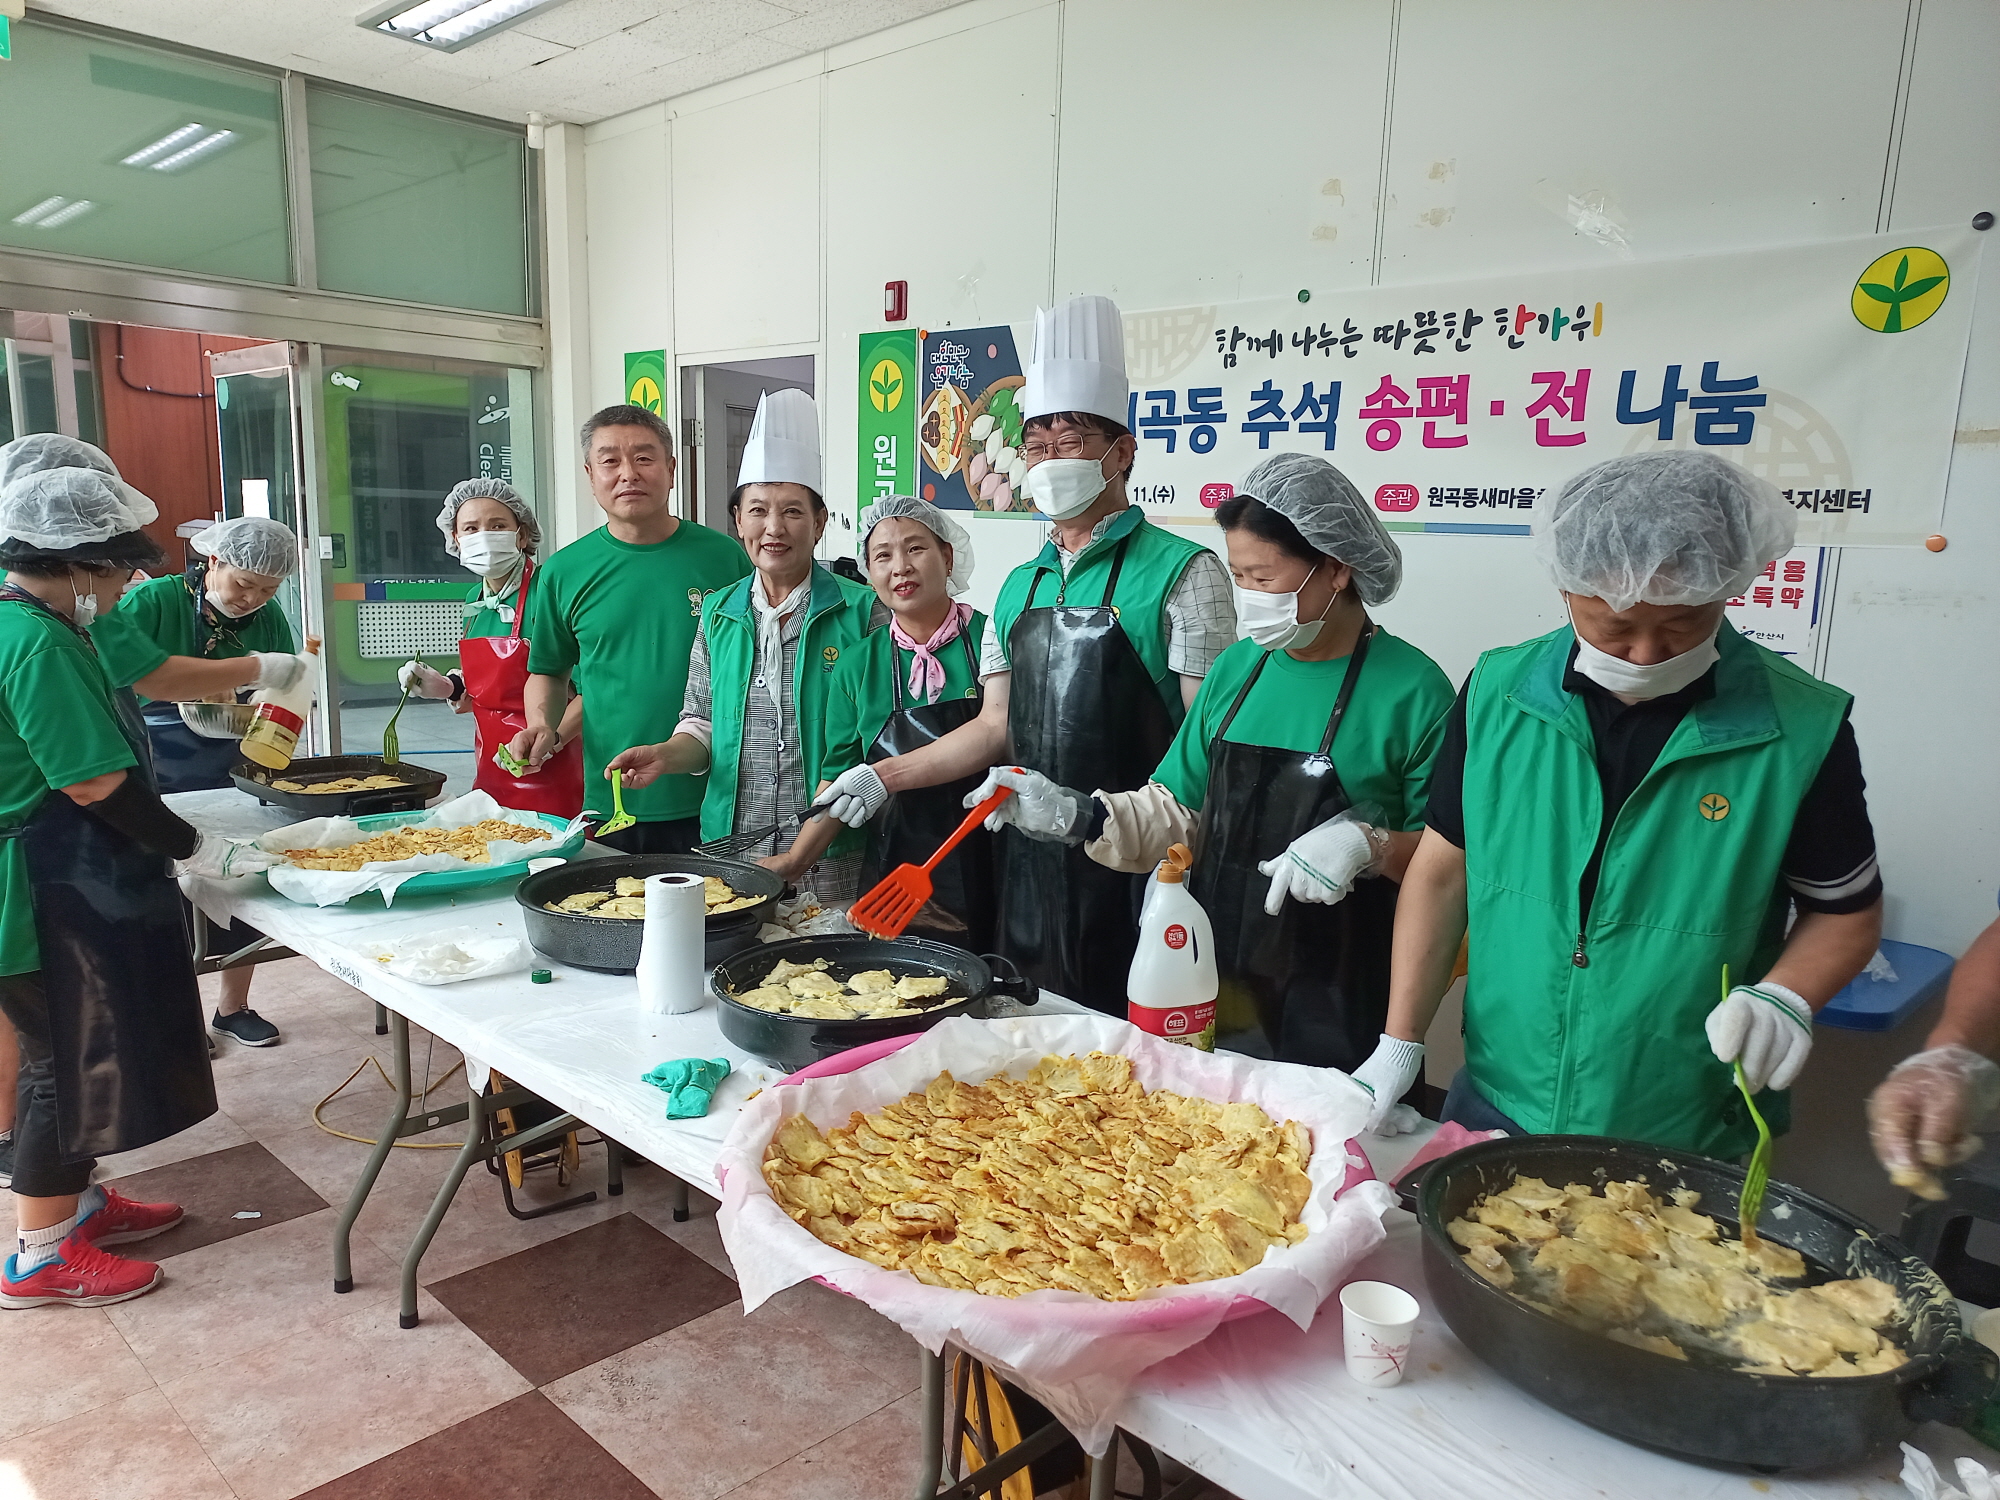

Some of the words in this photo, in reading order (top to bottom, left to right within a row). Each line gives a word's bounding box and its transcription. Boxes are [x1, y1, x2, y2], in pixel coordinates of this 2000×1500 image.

[931, 340, 970, 365] 대한민국
[1215, 325, 1283, 369] 함께
[1291, 318, 1364, 358] 나누는
[1373, 308, 1483, 355] 따뜻한
[1494, 302, 1603, 350] 한가위
[1128, 386, 1228, 454] 곡동
[1241, 379, 1342, 451] 추석
[1358, 373, 1471, 452] 송편
[1525, 368, 1592, 447] 전
[1616, 361, 1767, 446] 나눔
[1381, 488, 1413, 506] 주관
